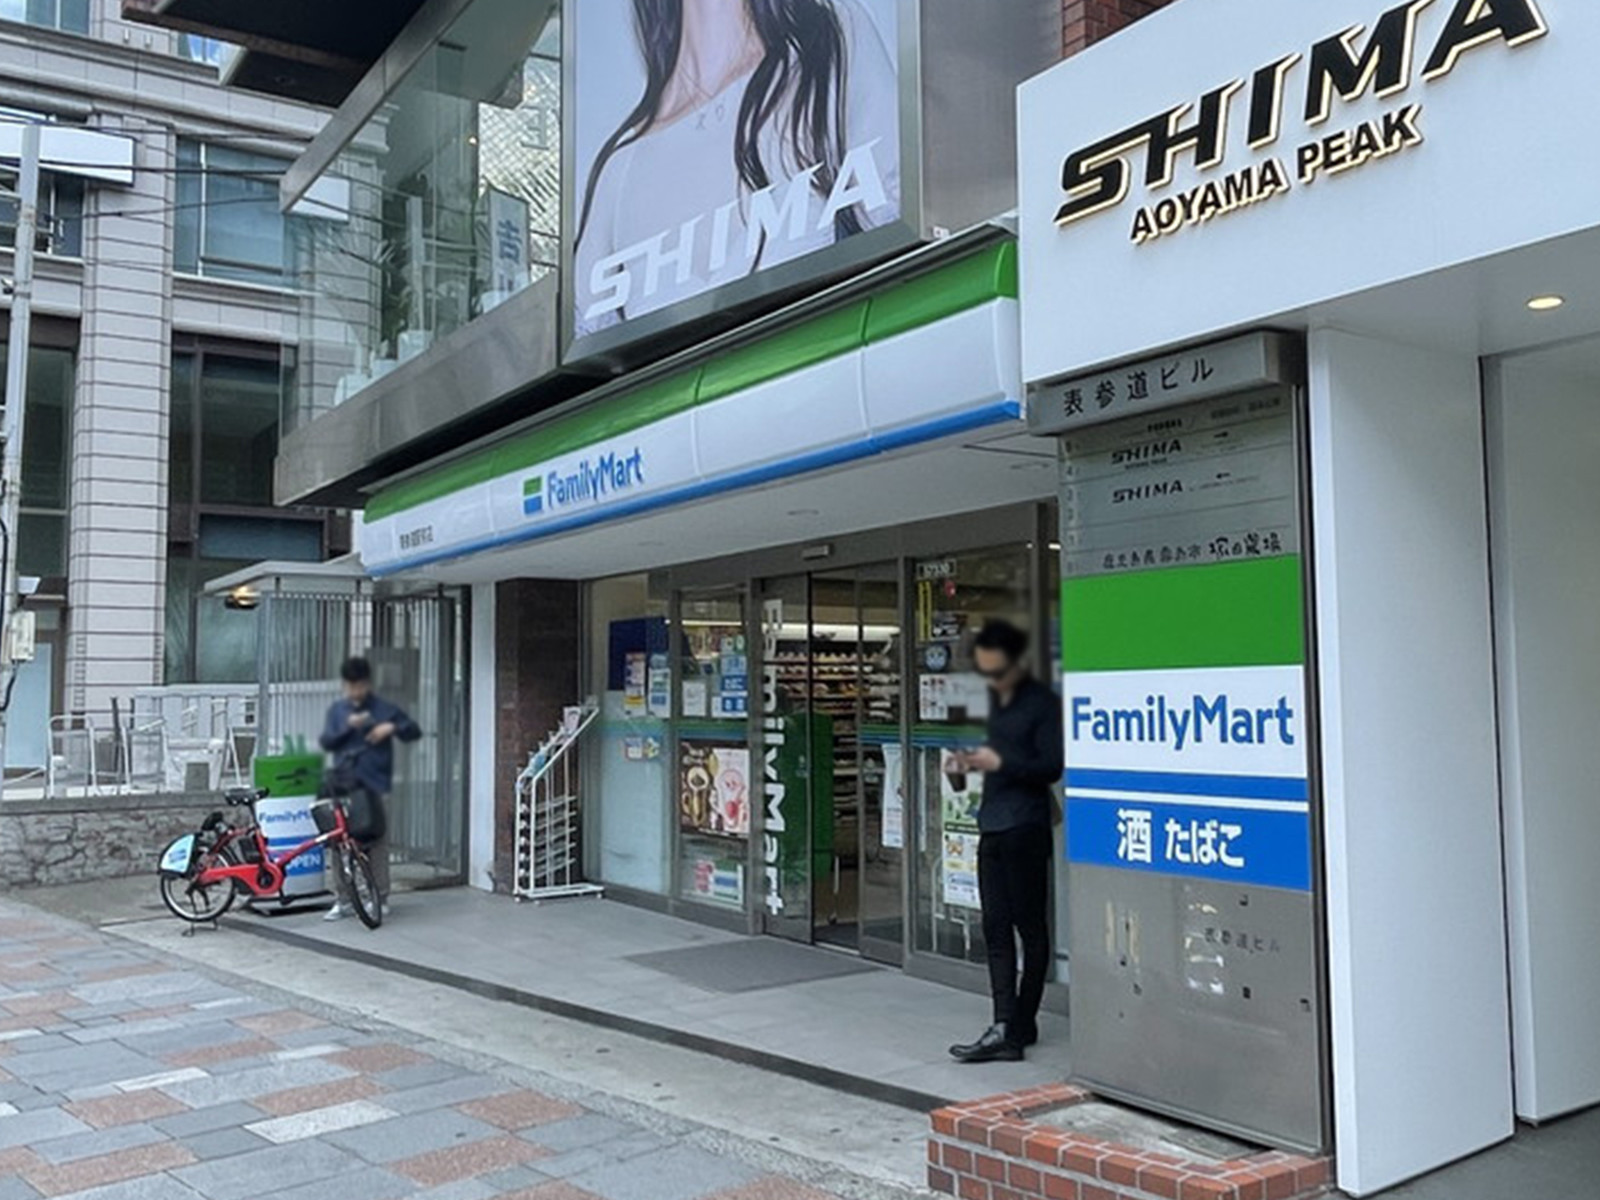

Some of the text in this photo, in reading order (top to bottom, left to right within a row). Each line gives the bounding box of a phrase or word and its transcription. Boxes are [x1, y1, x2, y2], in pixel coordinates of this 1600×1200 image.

[1054, 0, 1547, 224] SHIMA
[1130, 104, 1424, 244] AOYAMA PEAK
[585, 136, 893, 320] SHIMA
[1063, 359, 1214, 418] 表参道ビル
[547, 447, 644, 508] FamilyMart
[1111, 439, 1182, 465] SHIMA
[1112, 480, 1184, 504] SHIMA
[1071, 694, 1294, 751] FamilyMart
[762, 599, 786, 915] FamilyMart
[1117, 808, 1245, 868] 酒 たばこ
